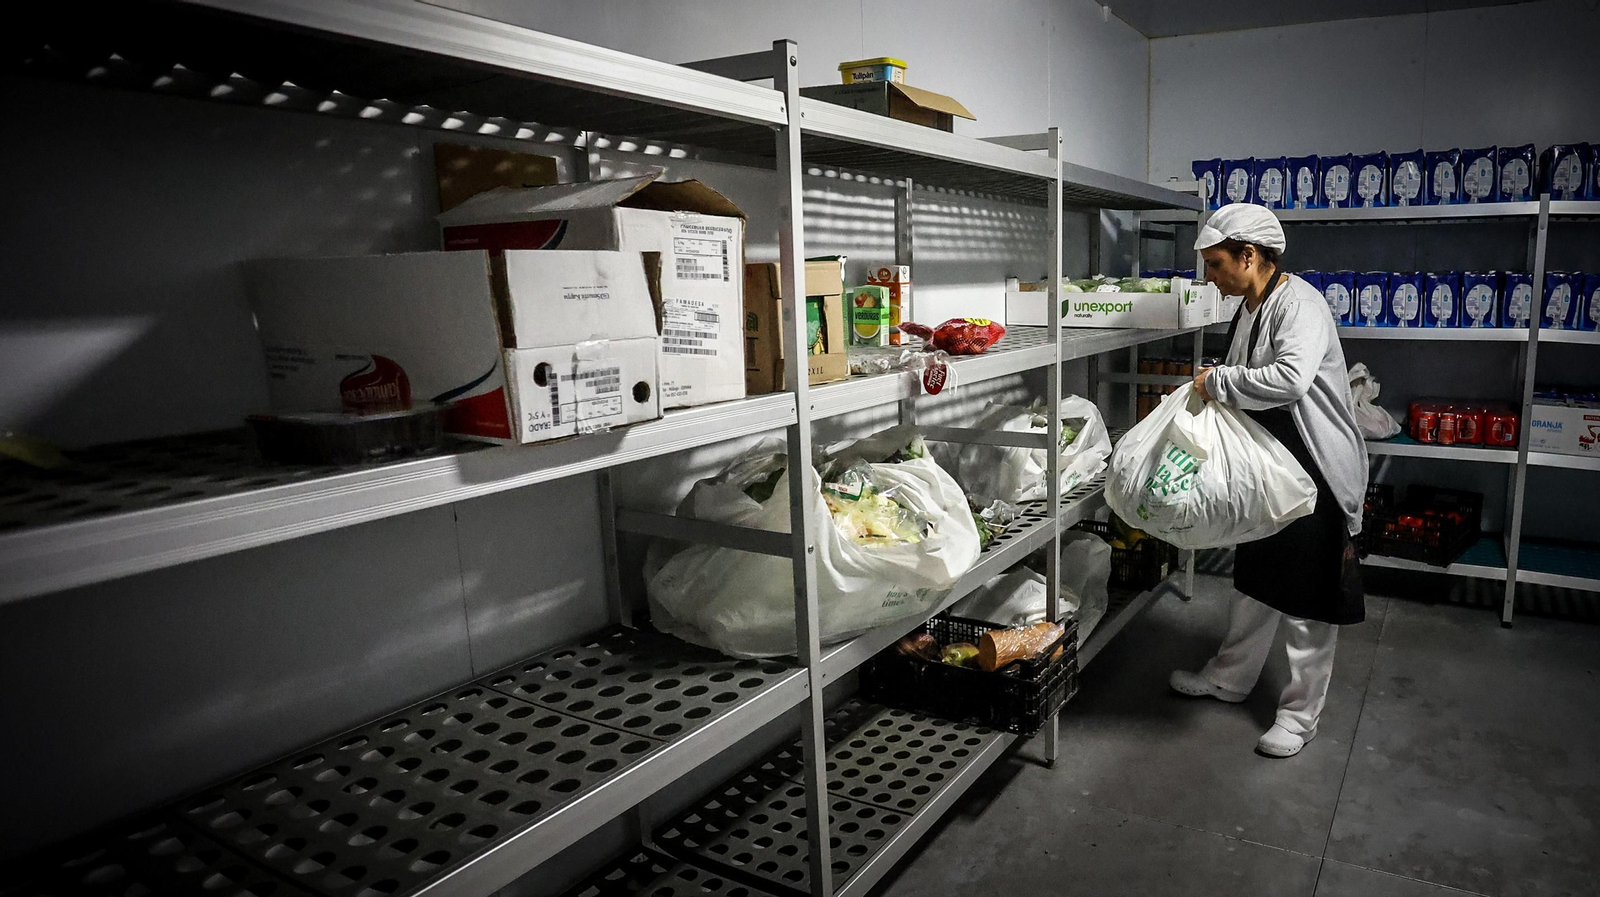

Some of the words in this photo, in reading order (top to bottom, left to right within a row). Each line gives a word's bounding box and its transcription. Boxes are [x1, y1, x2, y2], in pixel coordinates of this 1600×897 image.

[852, 72, 874, 80] Tulipán
[675, 298, 704, 307] FAMADESA
[1074, 301, 1133, 316] unexport
[1531, 420, 1563, 429] GRANJA
